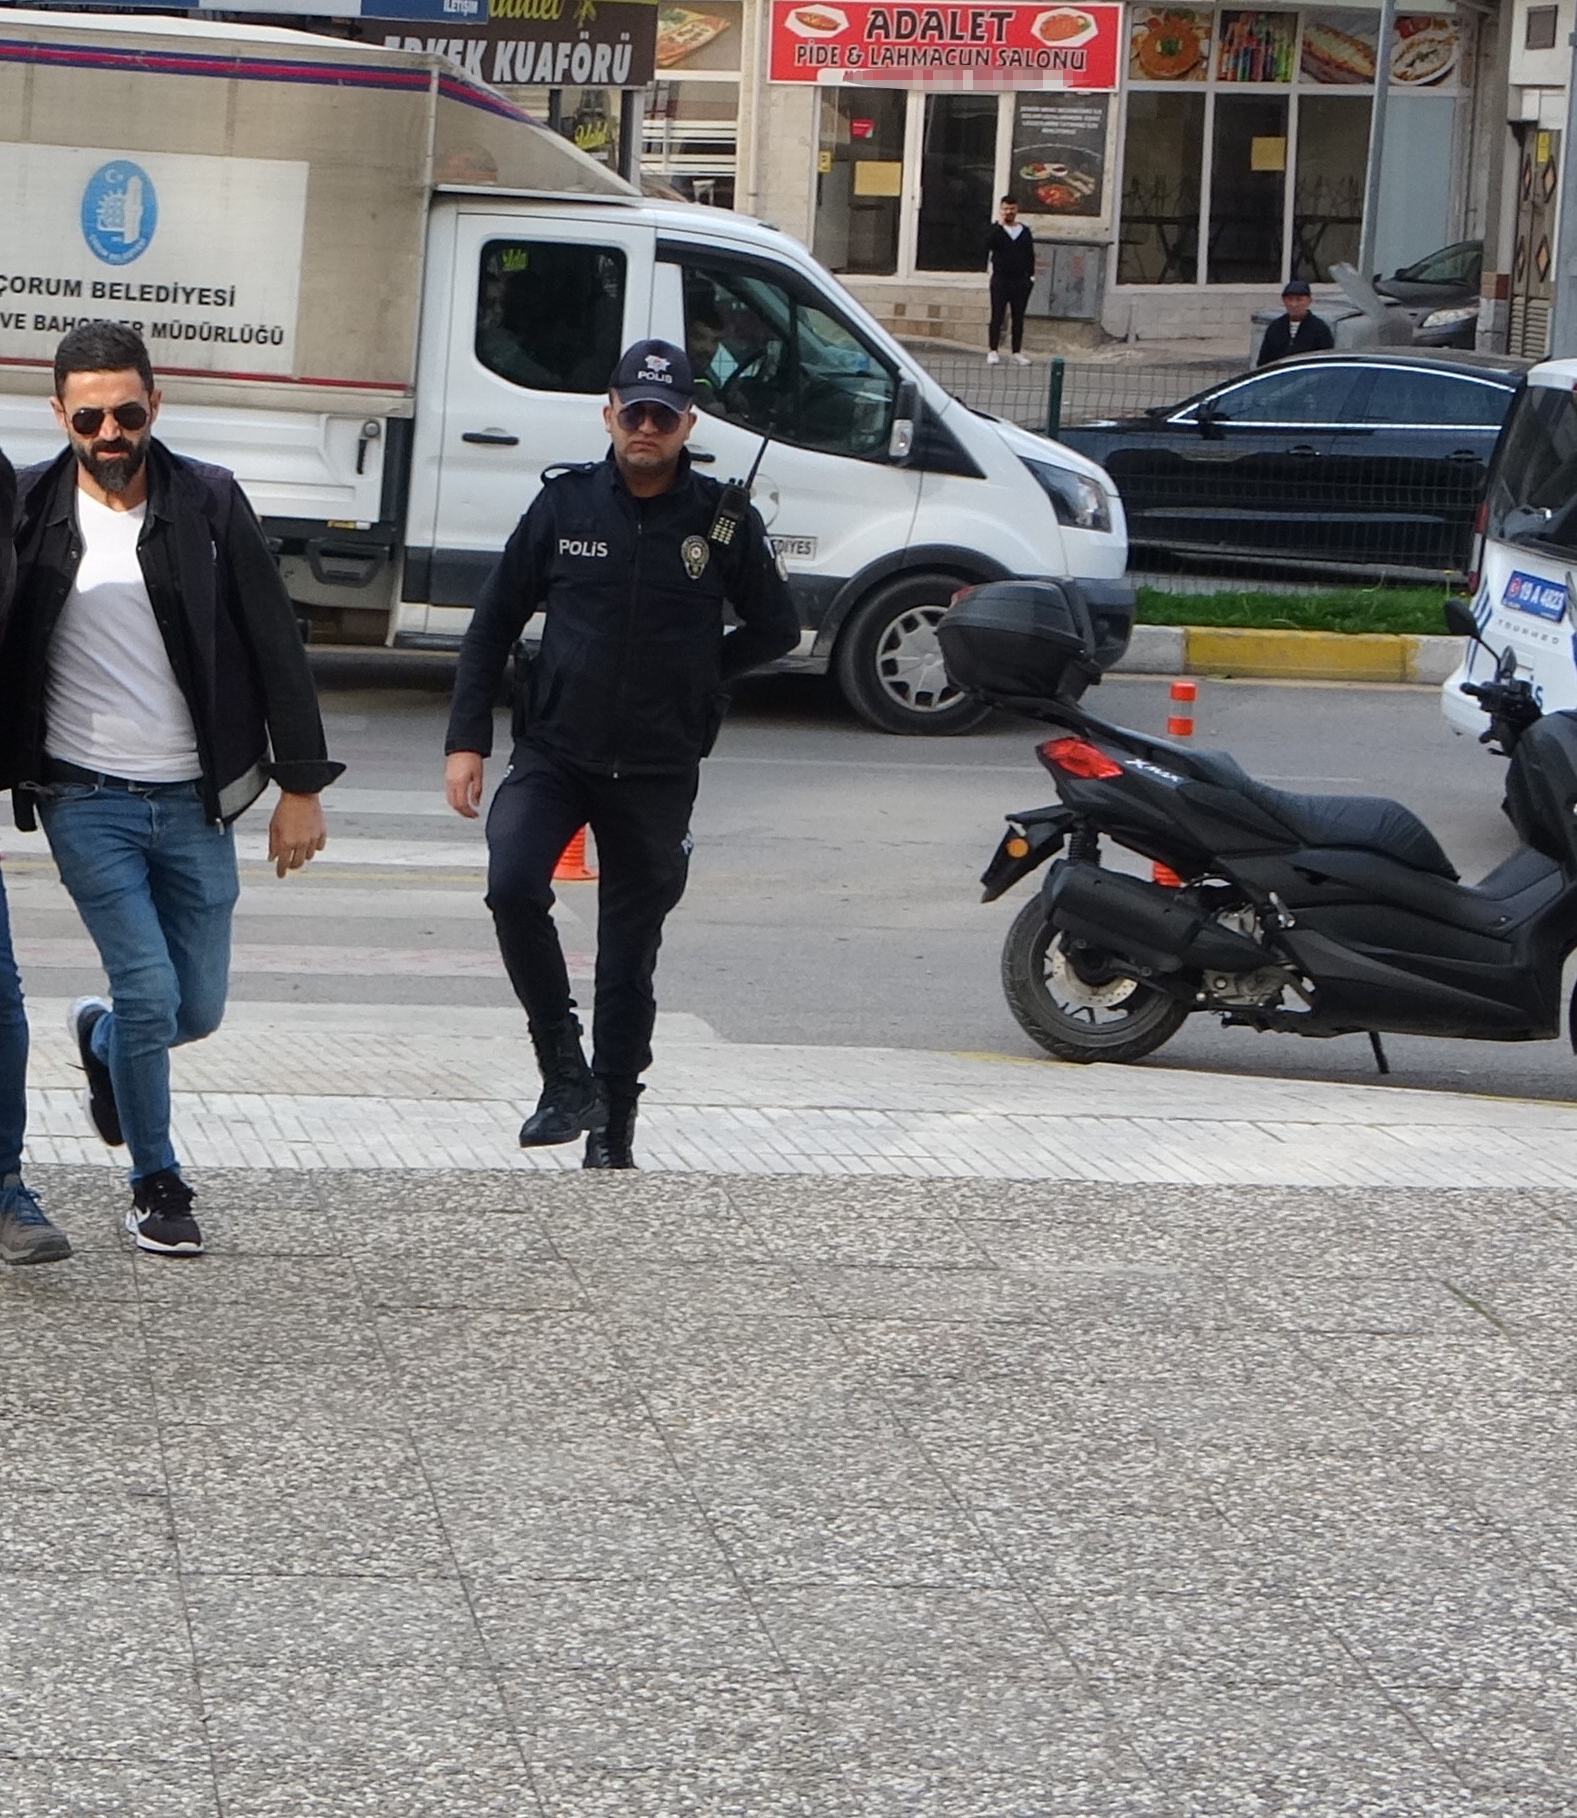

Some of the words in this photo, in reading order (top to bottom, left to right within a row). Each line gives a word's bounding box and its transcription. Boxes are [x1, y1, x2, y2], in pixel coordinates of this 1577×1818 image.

[866, 9, 1017, 43] ADALET
[492, 32, 633, 84] KUAFÖRÜ
[795, 40, 840, 67] PİDE
[868, 45, 991, 67] LAHMACUN
[997, 48, 1087, 71] SALONU
[92, 281, 236, 307] BELEDİYESİ
[1, 313, 26, 330] VE
[152, 319, 284, 345] MÜDÜRLÜĞÜ
